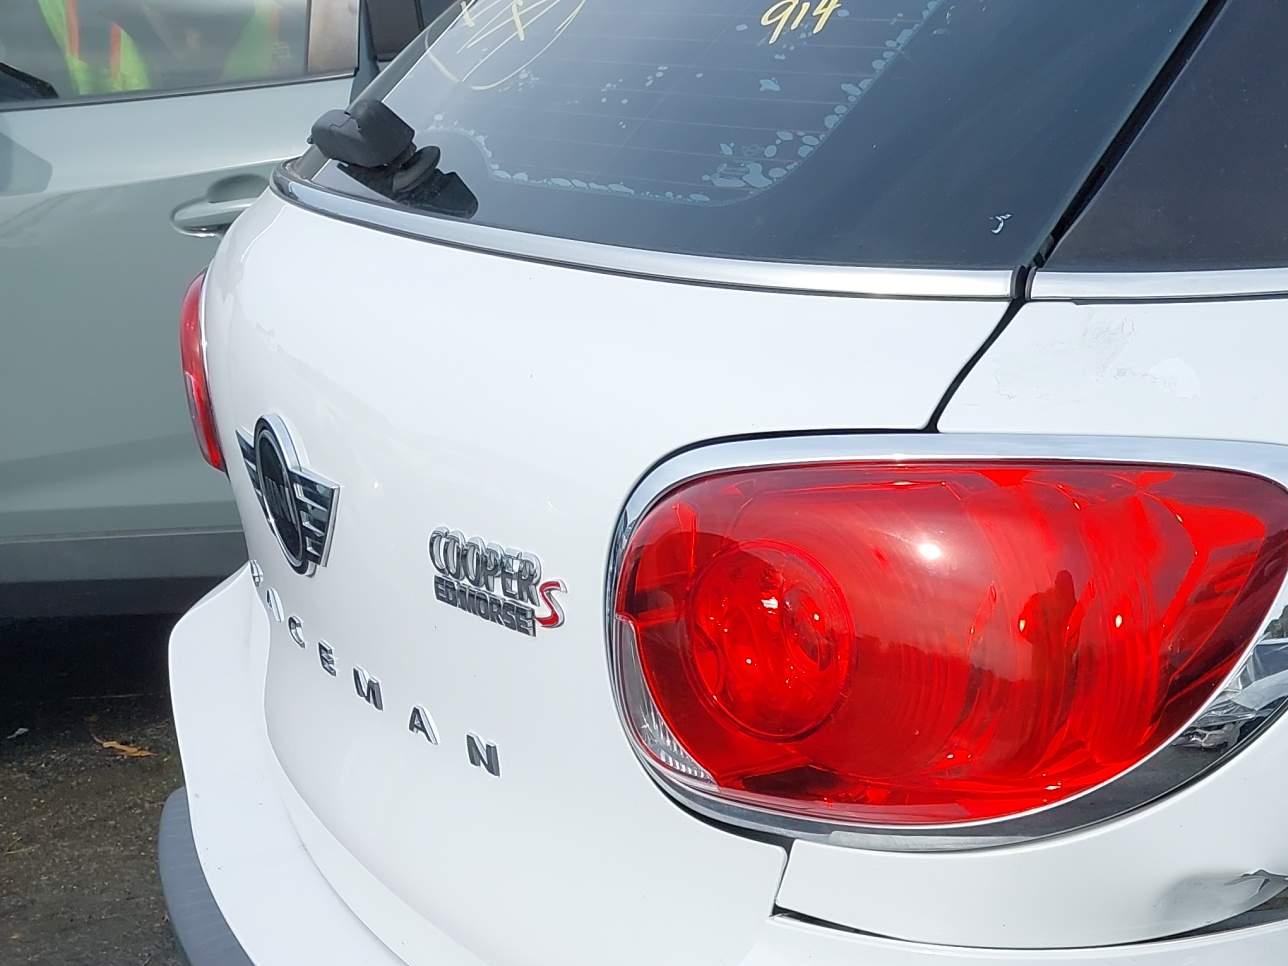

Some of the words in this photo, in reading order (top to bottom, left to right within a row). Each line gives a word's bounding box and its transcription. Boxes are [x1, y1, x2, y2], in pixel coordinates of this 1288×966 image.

[761, 0, 841, 44] 914
[429, 527, 541, 607] COOPER
[534, 579, 568, 628] S
